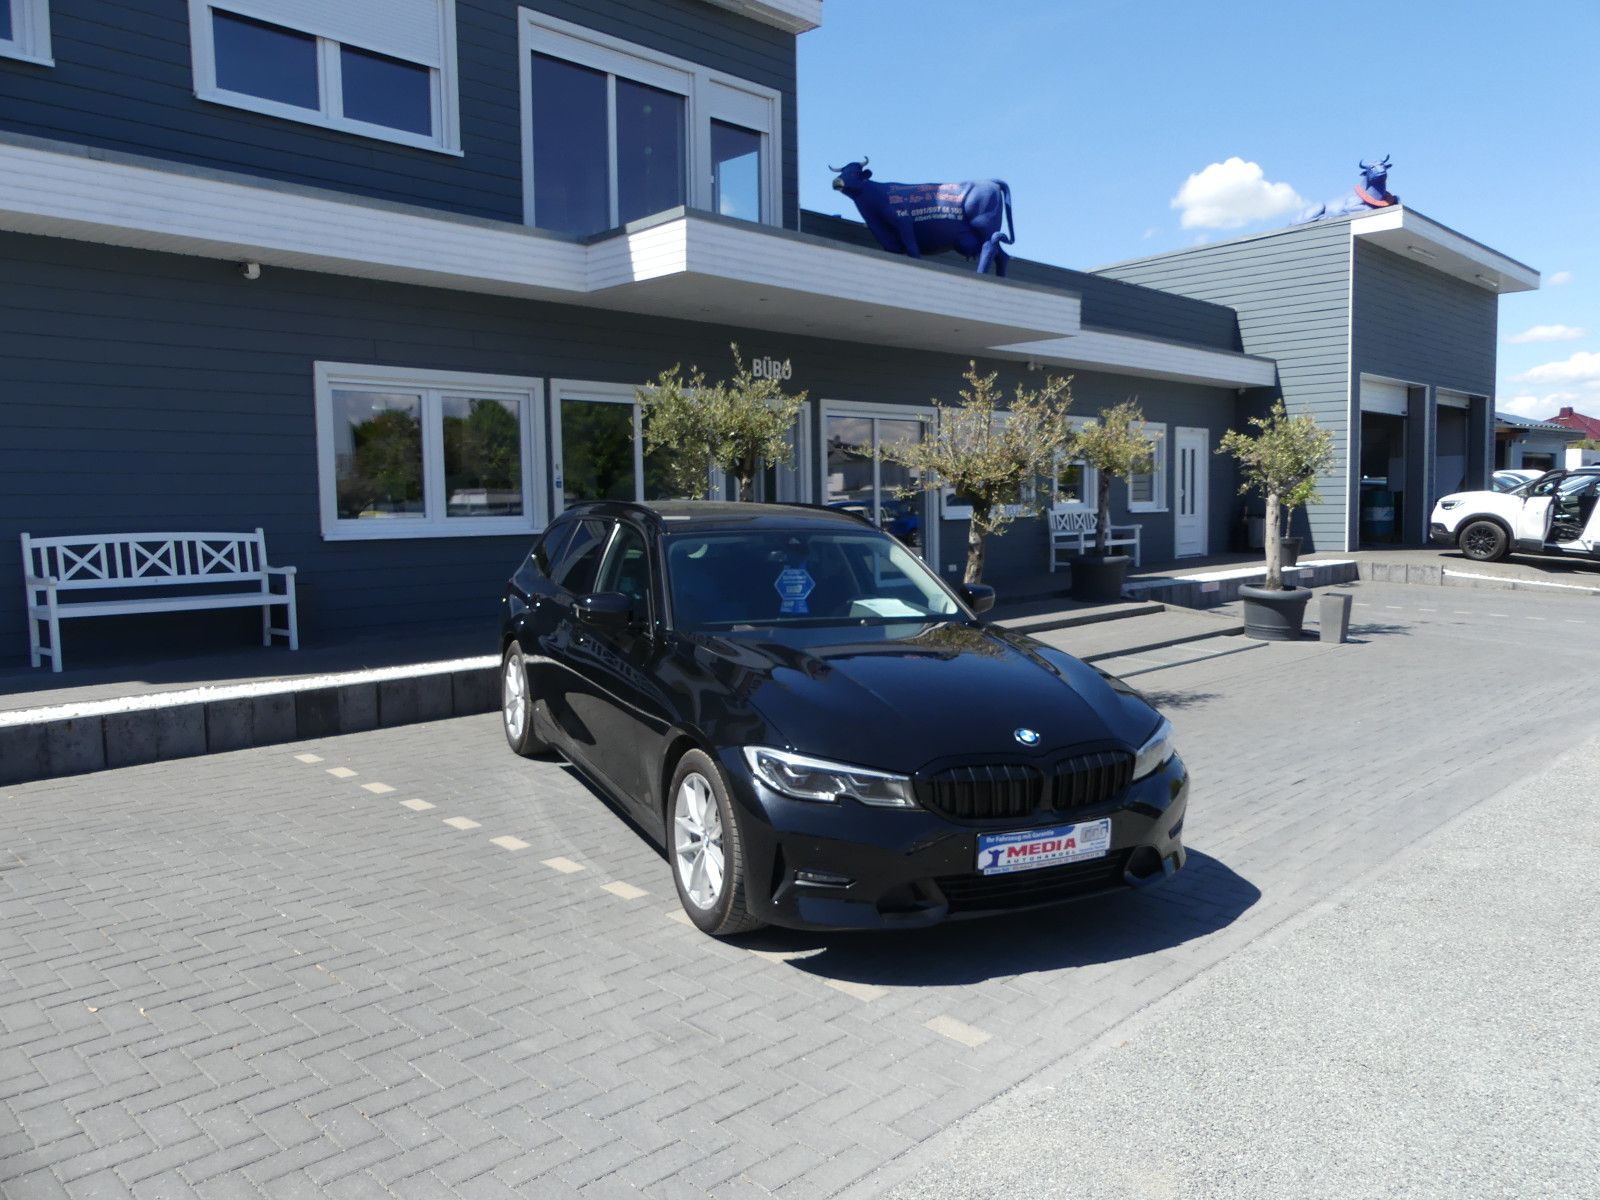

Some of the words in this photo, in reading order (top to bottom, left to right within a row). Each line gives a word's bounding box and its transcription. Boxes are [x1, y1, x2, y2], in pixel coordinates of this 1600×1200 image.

[752, 356, 792, 380] BÜRO
[1007, 838, 1077, 857] MEDIA
[1007, 850, 1076, 864] AUTOHANDEL
